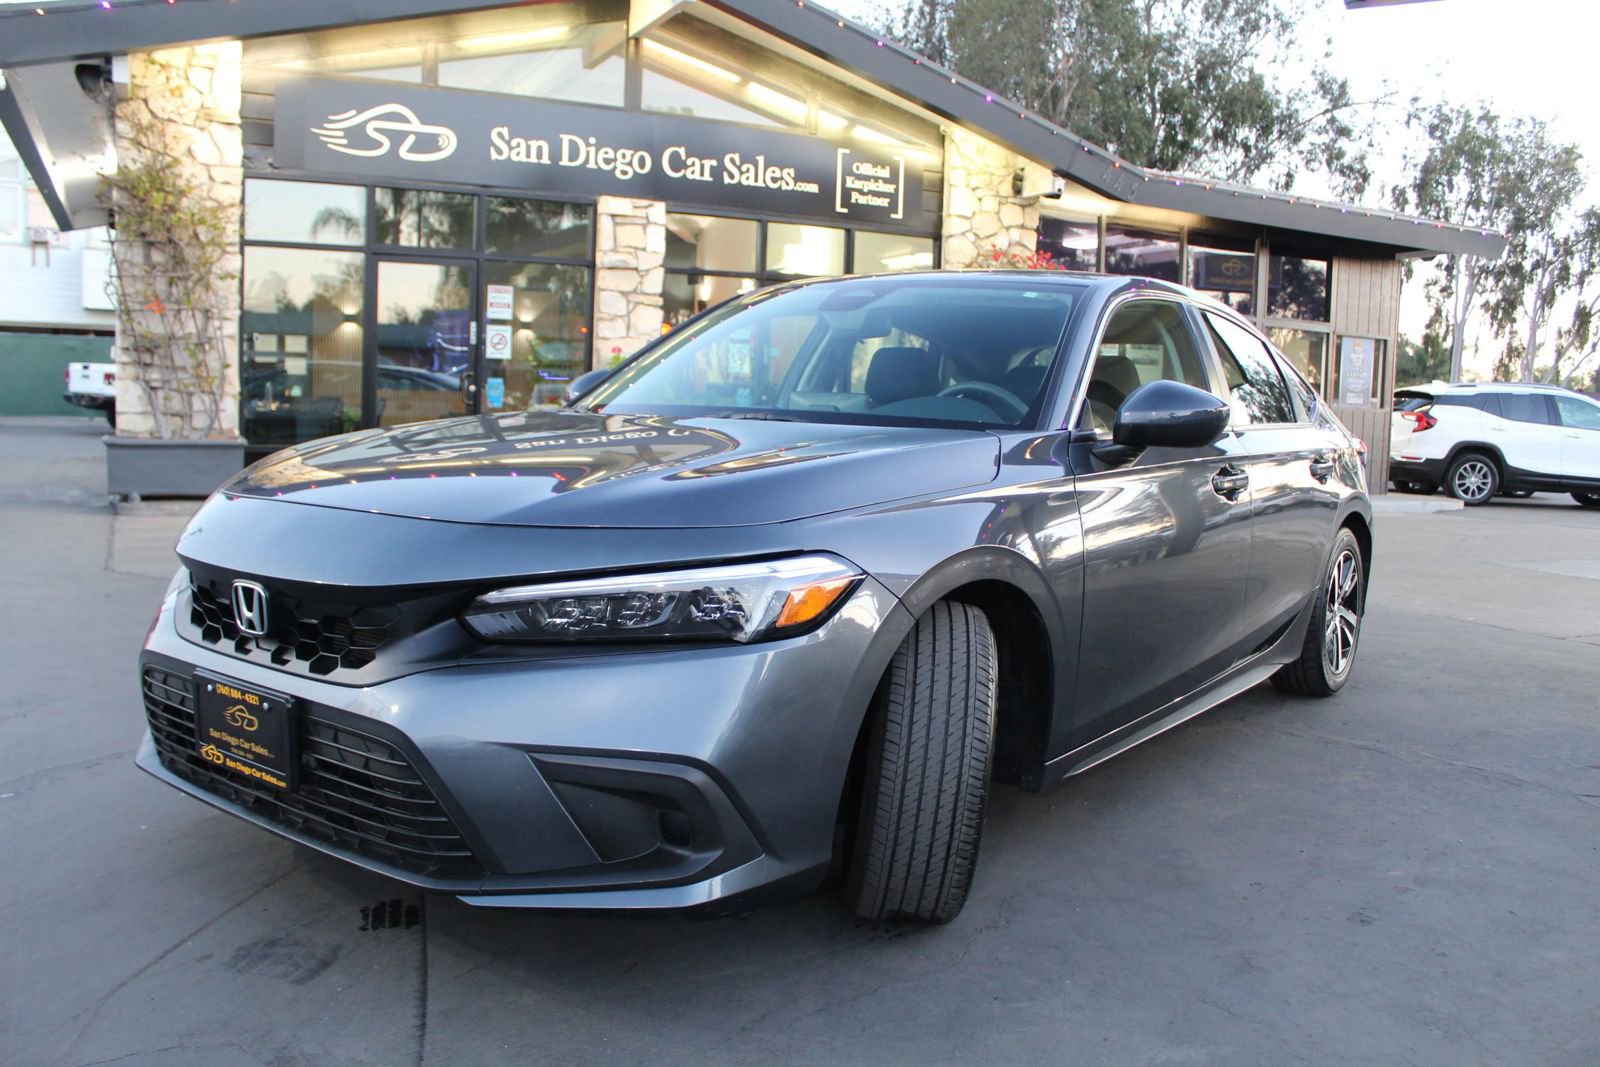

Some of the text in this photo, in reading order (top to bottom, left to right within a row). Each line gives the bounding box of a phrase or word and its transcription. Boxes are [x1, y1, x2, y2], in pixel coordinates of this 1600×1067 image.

[490, 126, 551, 165] San
[559, 133, 652, 180] Diego
[662, 145, 717, 182] Car
[852, 162, 890, 178] Official
[851, 191, 890, 207] Partner
[209, 728, 221, 738] San
[221, 732, 240, 746] Diego
[239, 738, 251, 749] Car
[226, 758, 236, 768] San
[236, 762, 252, 775] Diego
[251, 767, 262, 778] Car
